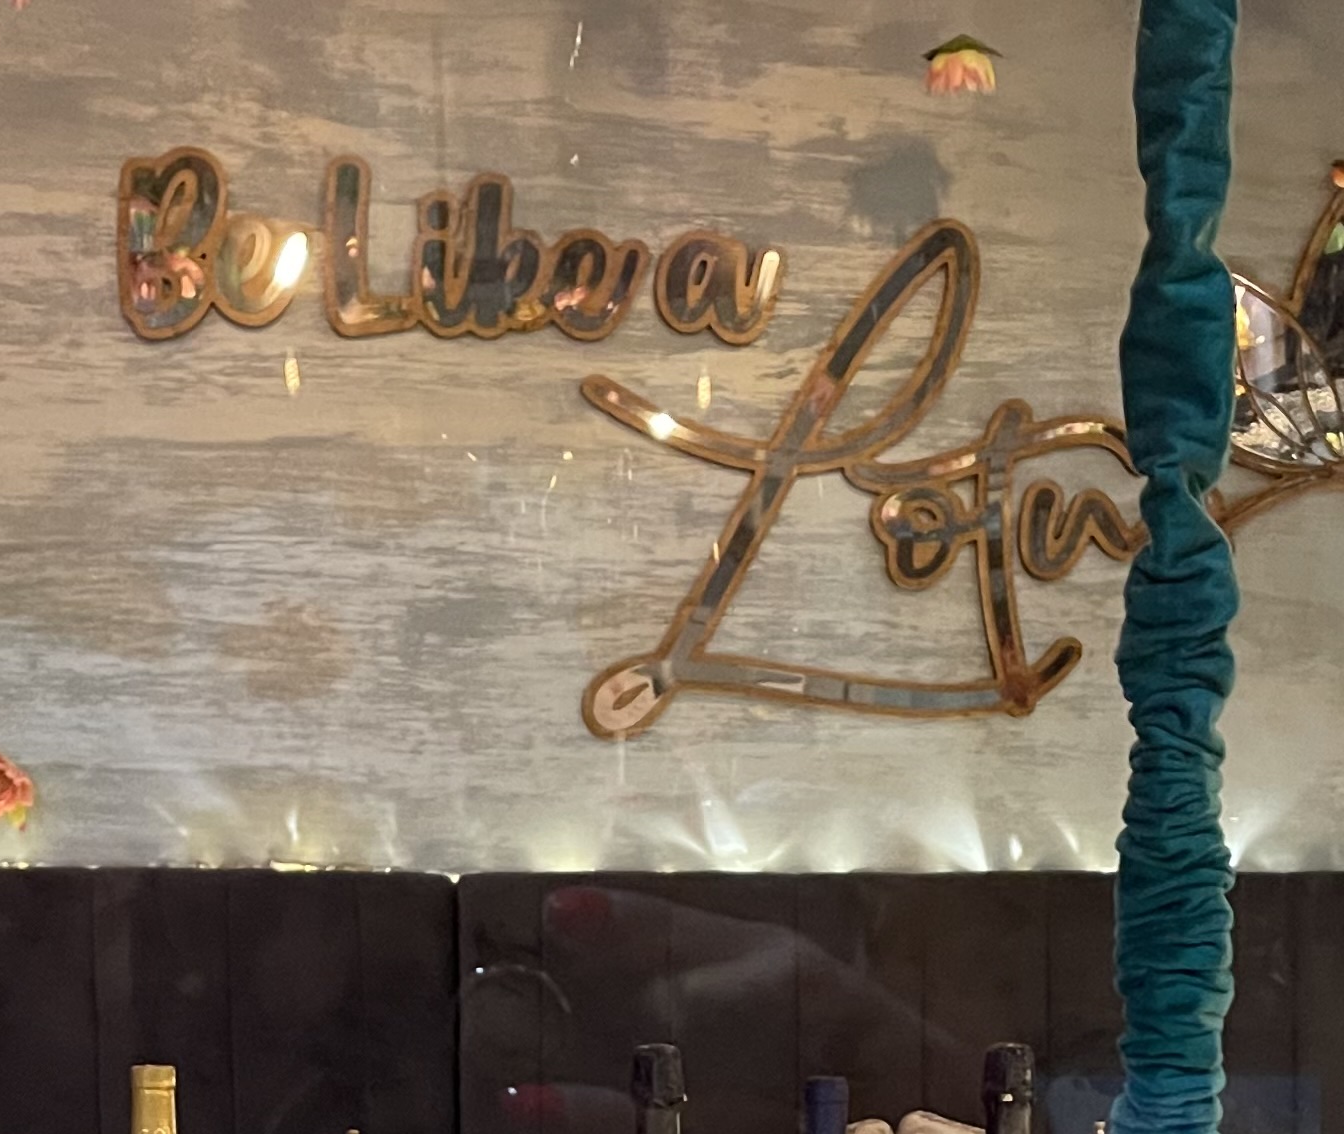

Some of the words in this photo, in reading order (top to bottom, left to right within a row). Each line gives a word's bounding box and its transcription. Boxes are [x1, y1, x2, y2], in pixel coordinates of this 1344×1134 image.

[117, 145, 312, 341] Be
[324, 153, 650, 341] Like
[656, 229, 786, 346] a
[581, 218, 1151, 739] Lotu
